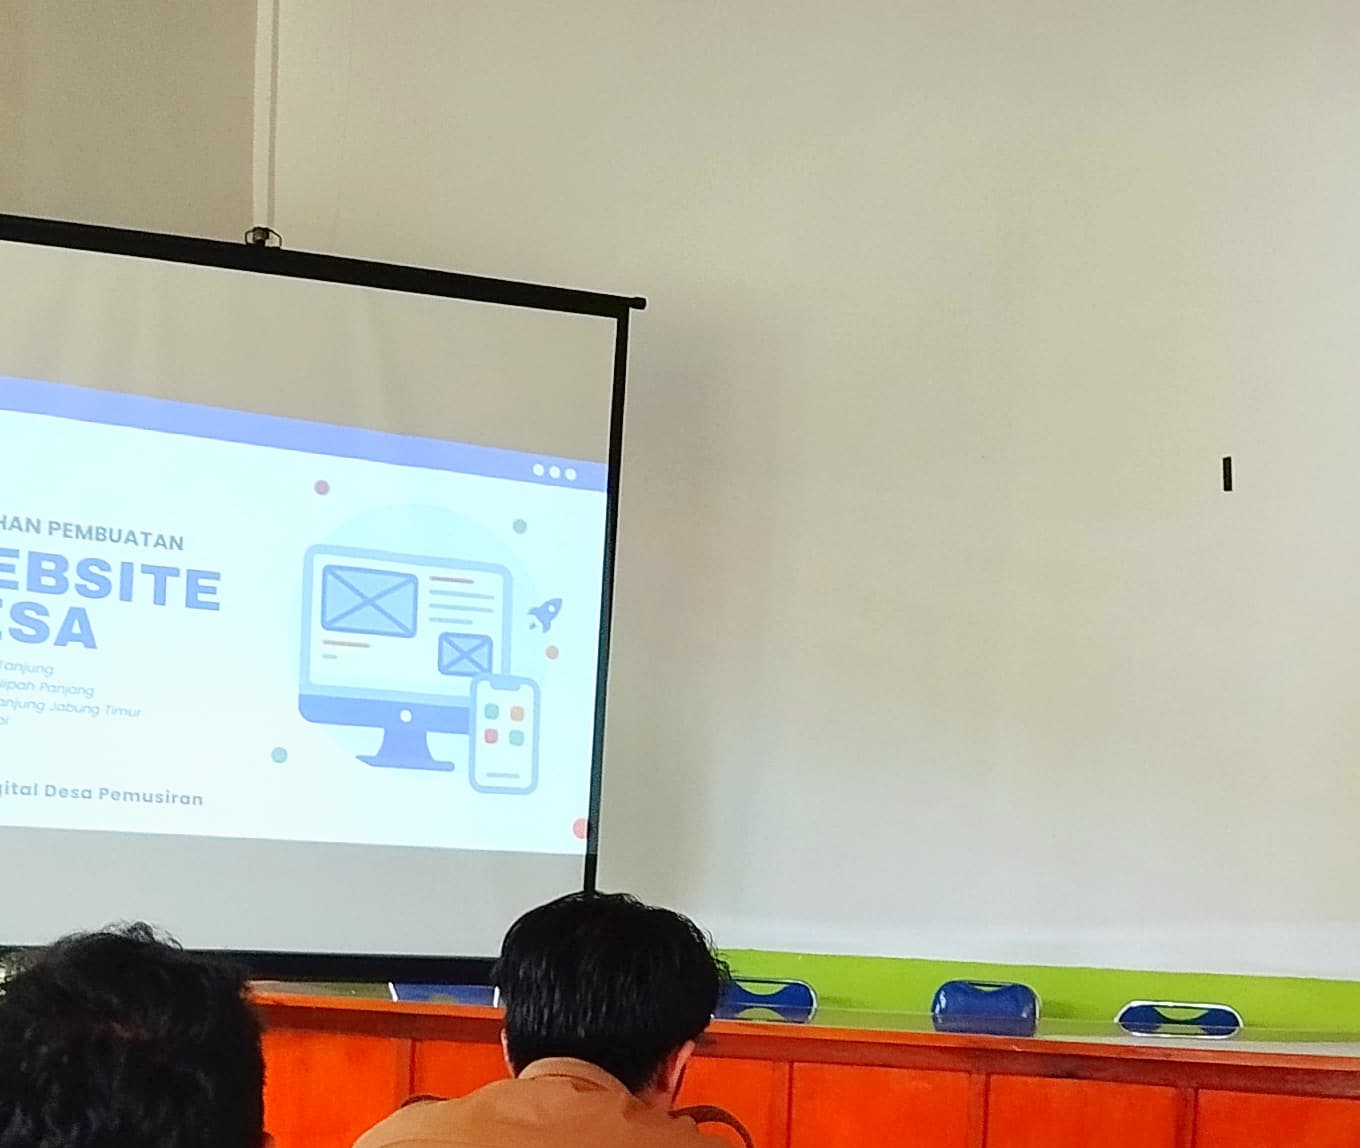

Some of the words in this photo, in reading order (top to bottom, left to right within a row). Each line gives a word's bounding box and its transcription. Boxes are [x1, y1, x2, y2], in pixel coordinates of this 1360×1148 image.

[48, 521, 184, 551] PEMBUATAN
[39, 681, 95, 698] Panjang
[49, 699, 100, 717] Jabung
[104, 703, 143, 718] Timur
[44, 783, 93, 800] Desa
[98, 786, 204, 807] Pemusiran
